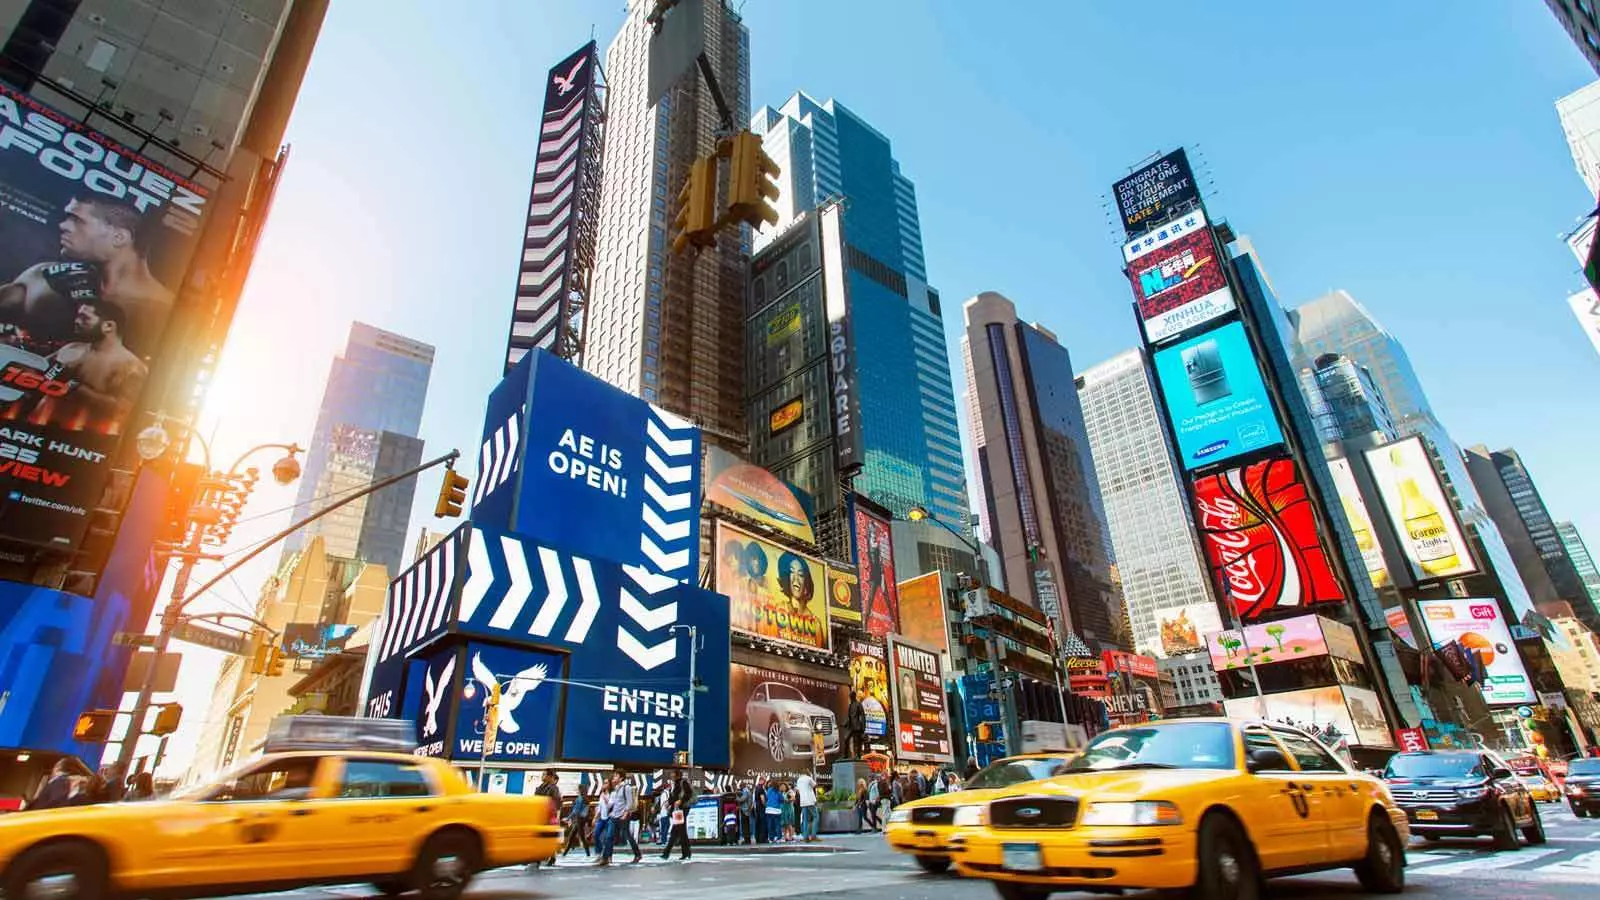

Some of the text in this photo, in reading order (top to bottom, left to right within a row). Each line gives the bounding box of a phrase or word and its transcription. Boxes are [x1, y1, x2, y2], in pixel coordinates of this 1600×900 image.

[0, 124, 161, 214] FOOT
[1118, 160, 1170, 192] CONGRATS
[1120, 164, 1180, 201] ON DAY ONE
[1122, 181, 1166, 208] OF YOUR
[1124, 178, 1188, 216] RETIREMENT
[1127, 206, 1153, 225] KATE
[49, 262, 84, 275] UFC
[1154, 303, 1229, 339] NEWS AGENCY
[1162, 300, 1215, 328] XINHUA
[3, 366, 69, 397] 160
[48, 440, 107, 464] HUNT
[558, 428, 623, 470] AE IS
[548, 451, 628, 498] OPEN!
[734, 595, 817, 637] MOTOWN
[1471, 606, 1493, 618] Gift
[897, 644, 938, 675] WANTED
[368, 690, 393, 720] THIS
[603, 685, 685, 719] ENTER
[460, 739, 540, 756] WEE OPEN
[610, 718, 677, 749] HERE
